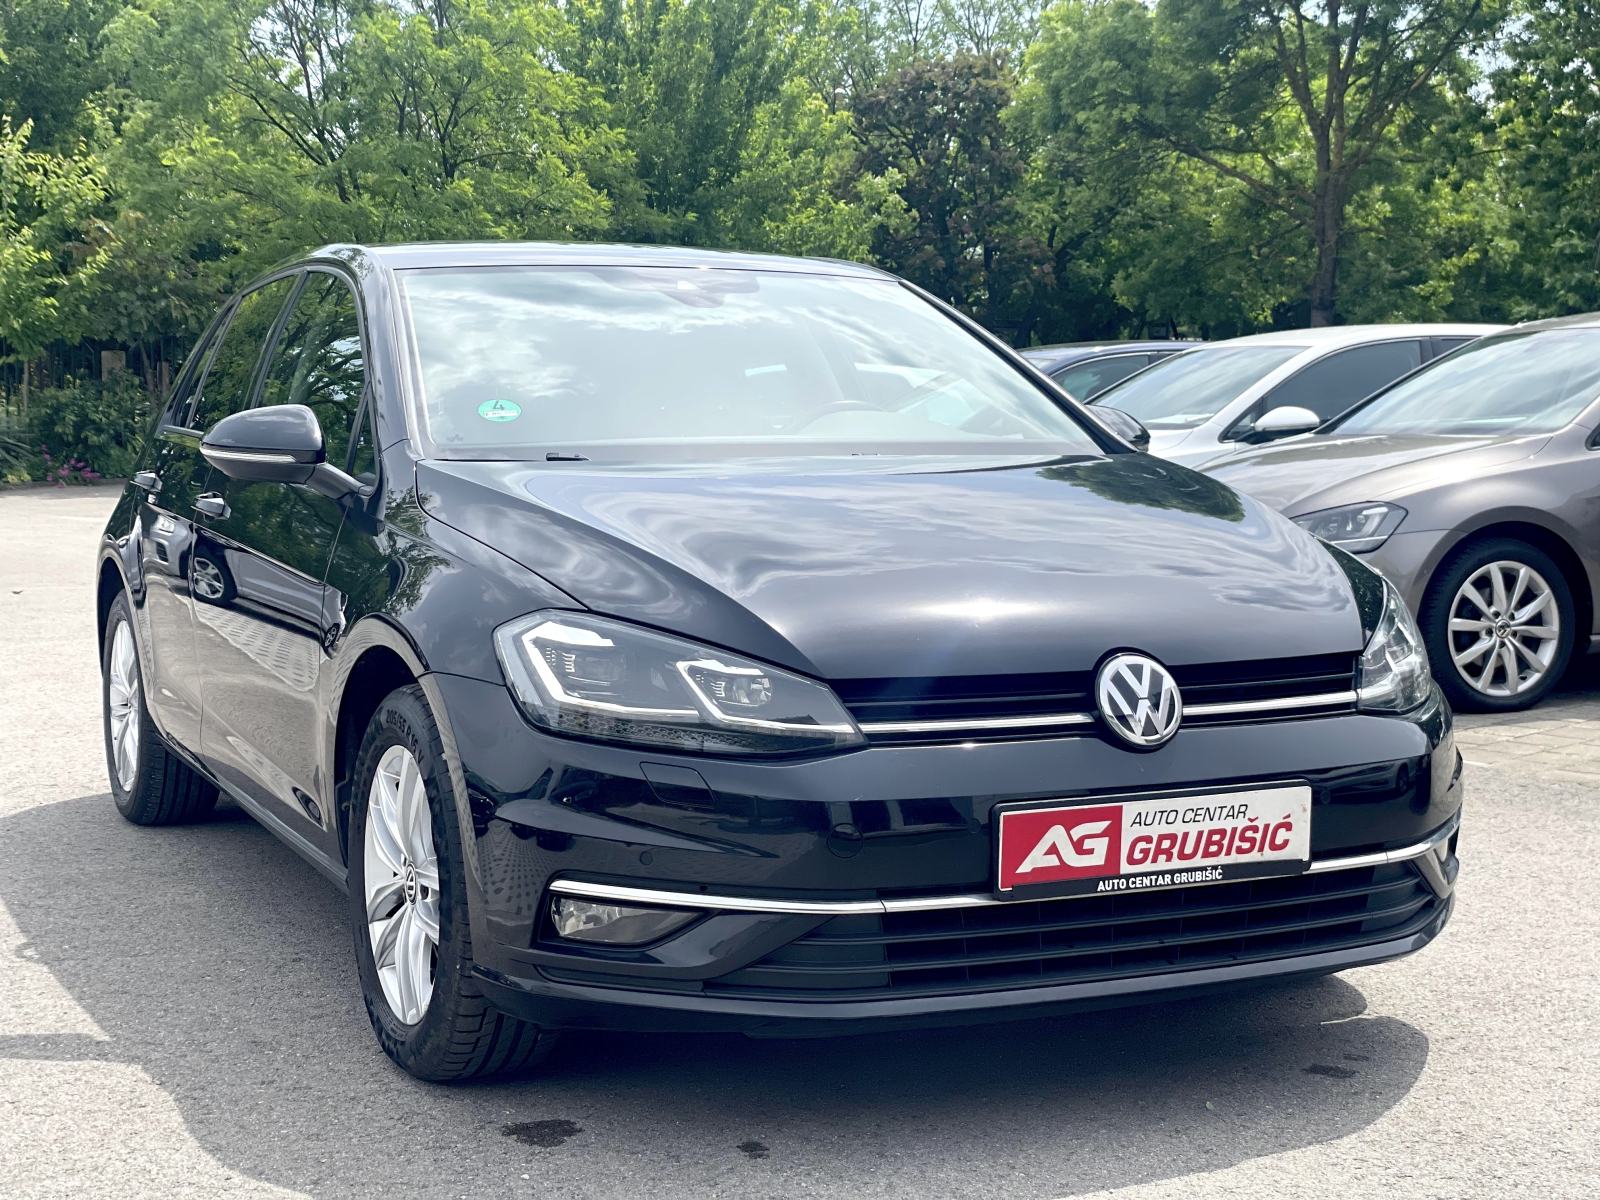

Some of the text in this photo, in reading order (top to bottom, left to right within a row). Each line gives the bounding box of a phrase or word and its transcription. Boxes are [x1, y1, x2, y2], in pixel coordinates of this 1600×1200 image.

[1130, 804, 1249, 828] AUTO CENTAR
[1015, 820, 1112, 874] AG
[1126, 813, 1293, 866] GRUBIŠIĆ
[1097, 866, 1223, 892] AUTO CENTAR GRUBIŠIĆ
